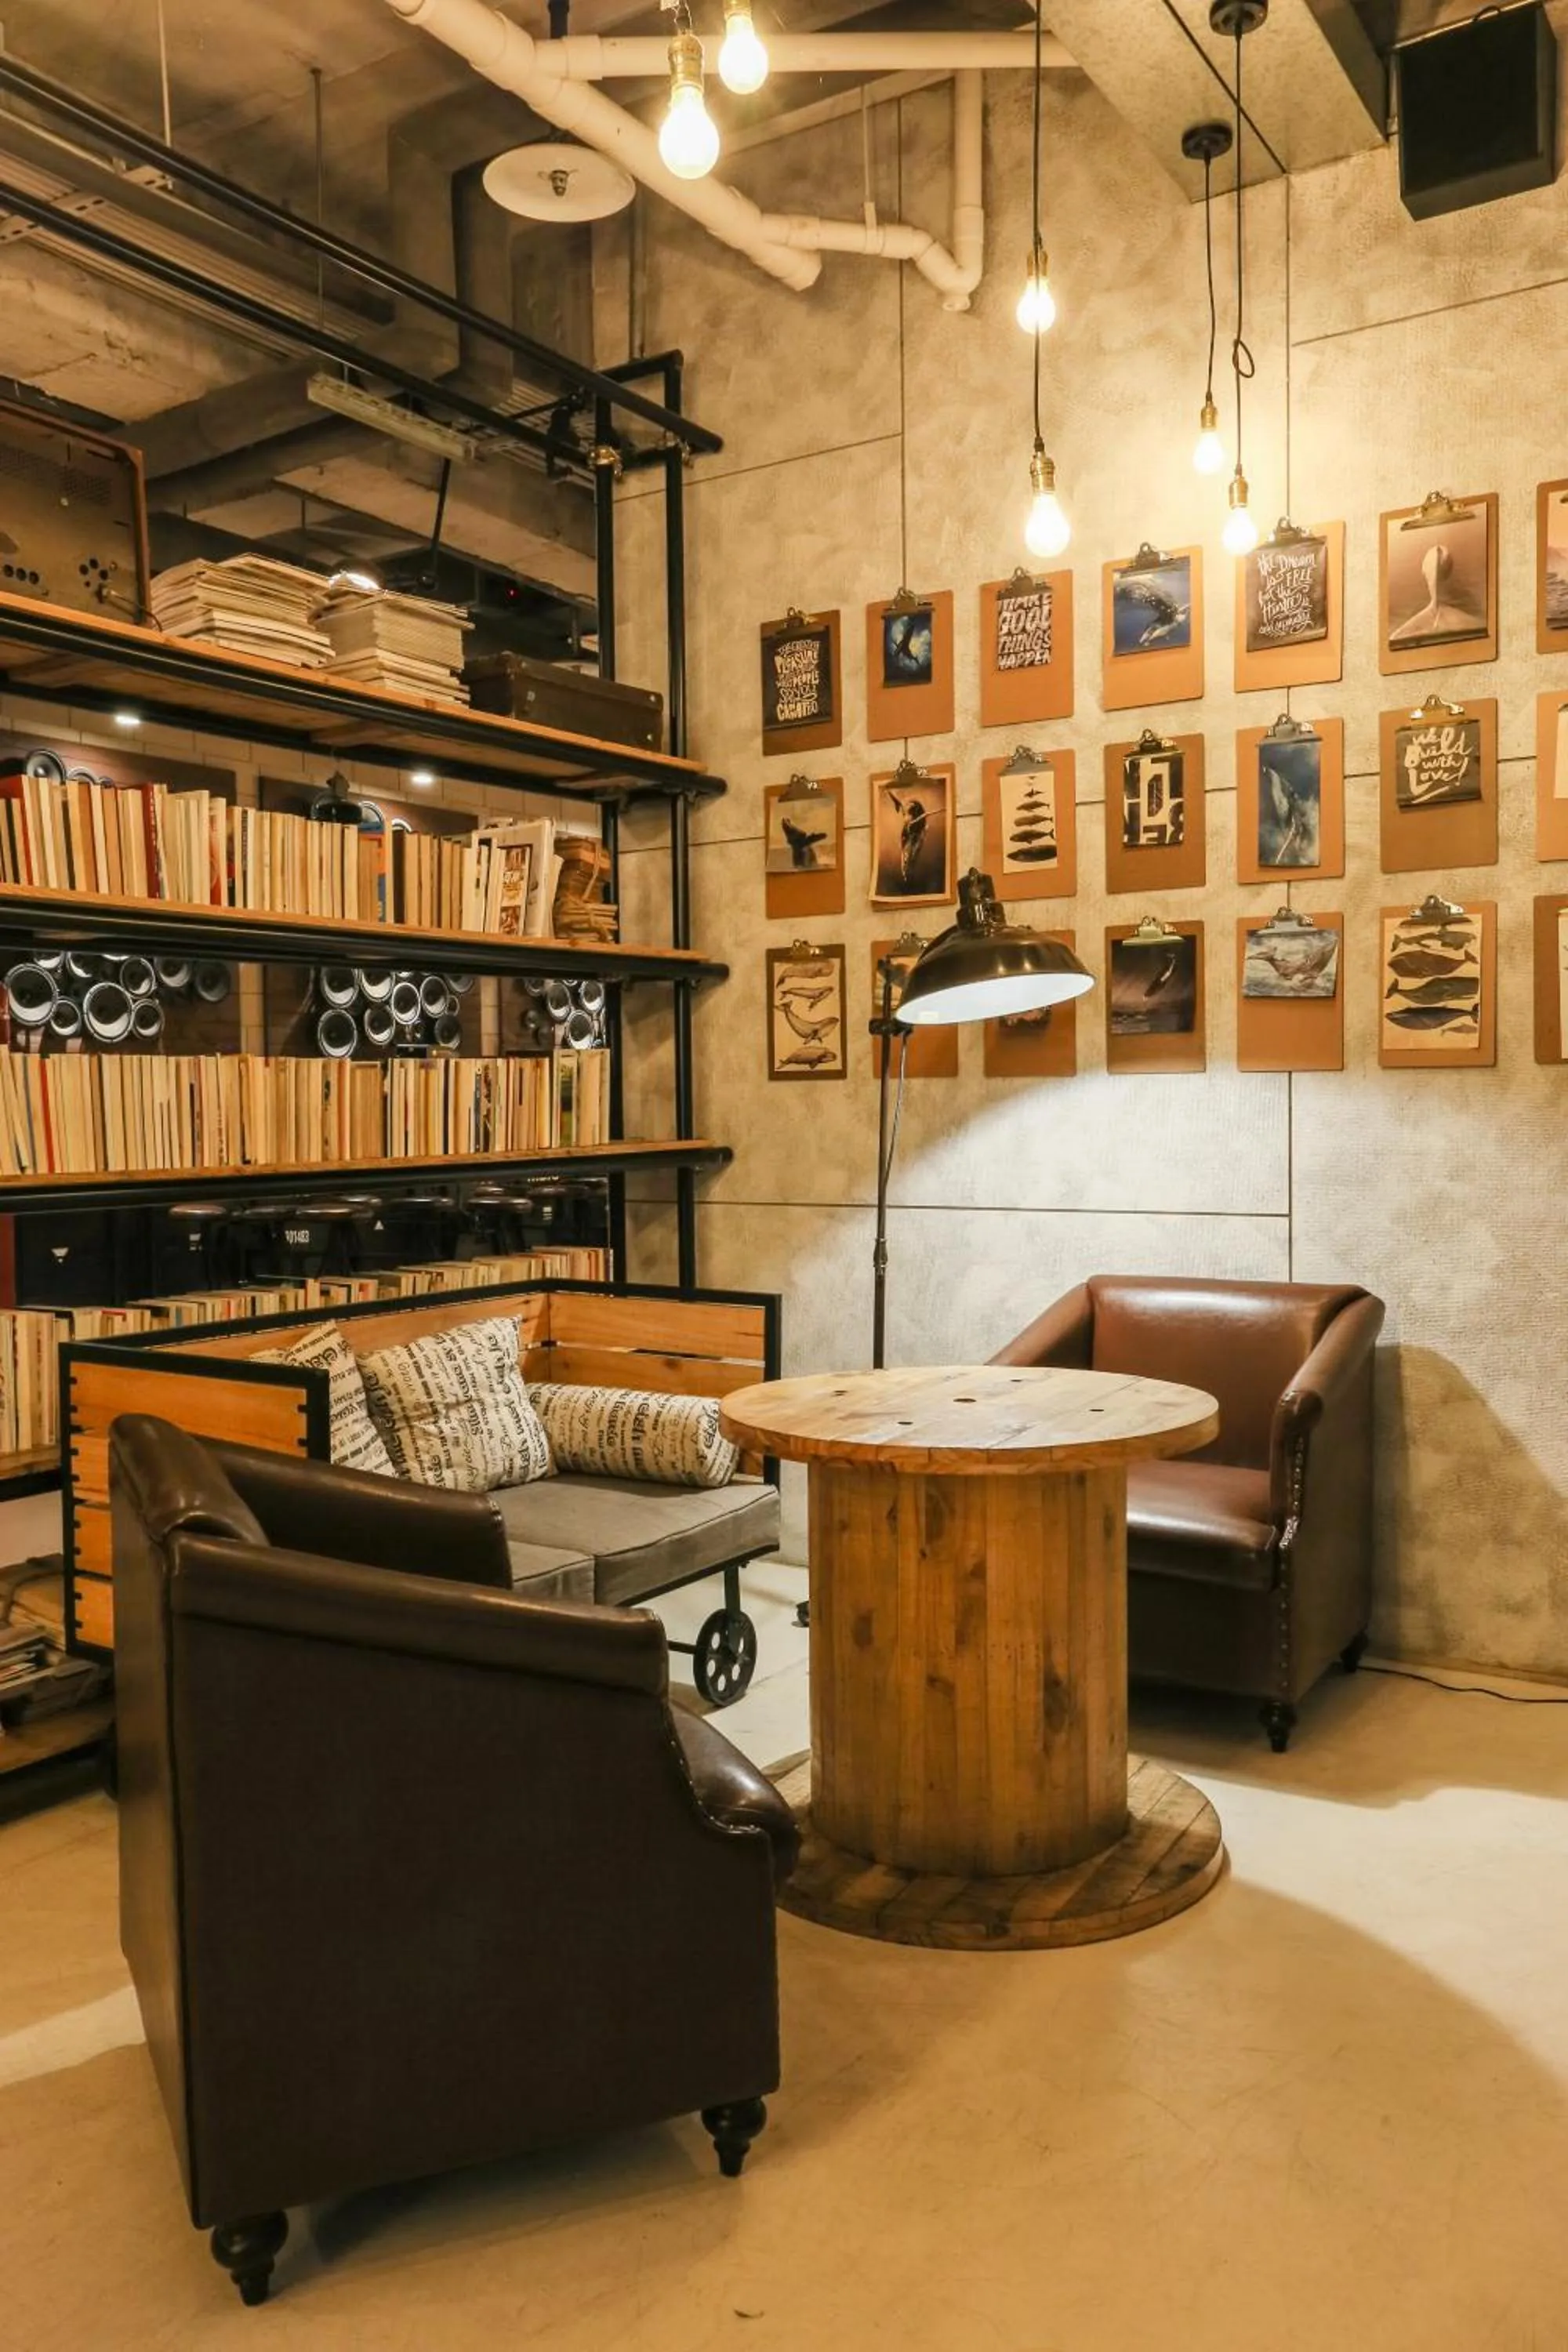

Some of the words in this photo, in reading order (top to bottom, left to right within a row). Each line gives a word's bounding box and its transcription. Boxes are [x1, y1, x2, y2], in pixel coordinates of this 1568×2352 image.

[1286, 568, 1312, 588] FREE
[998, 629, 1052, 653] THINGS
[1421, 754, 1461, 769] with
